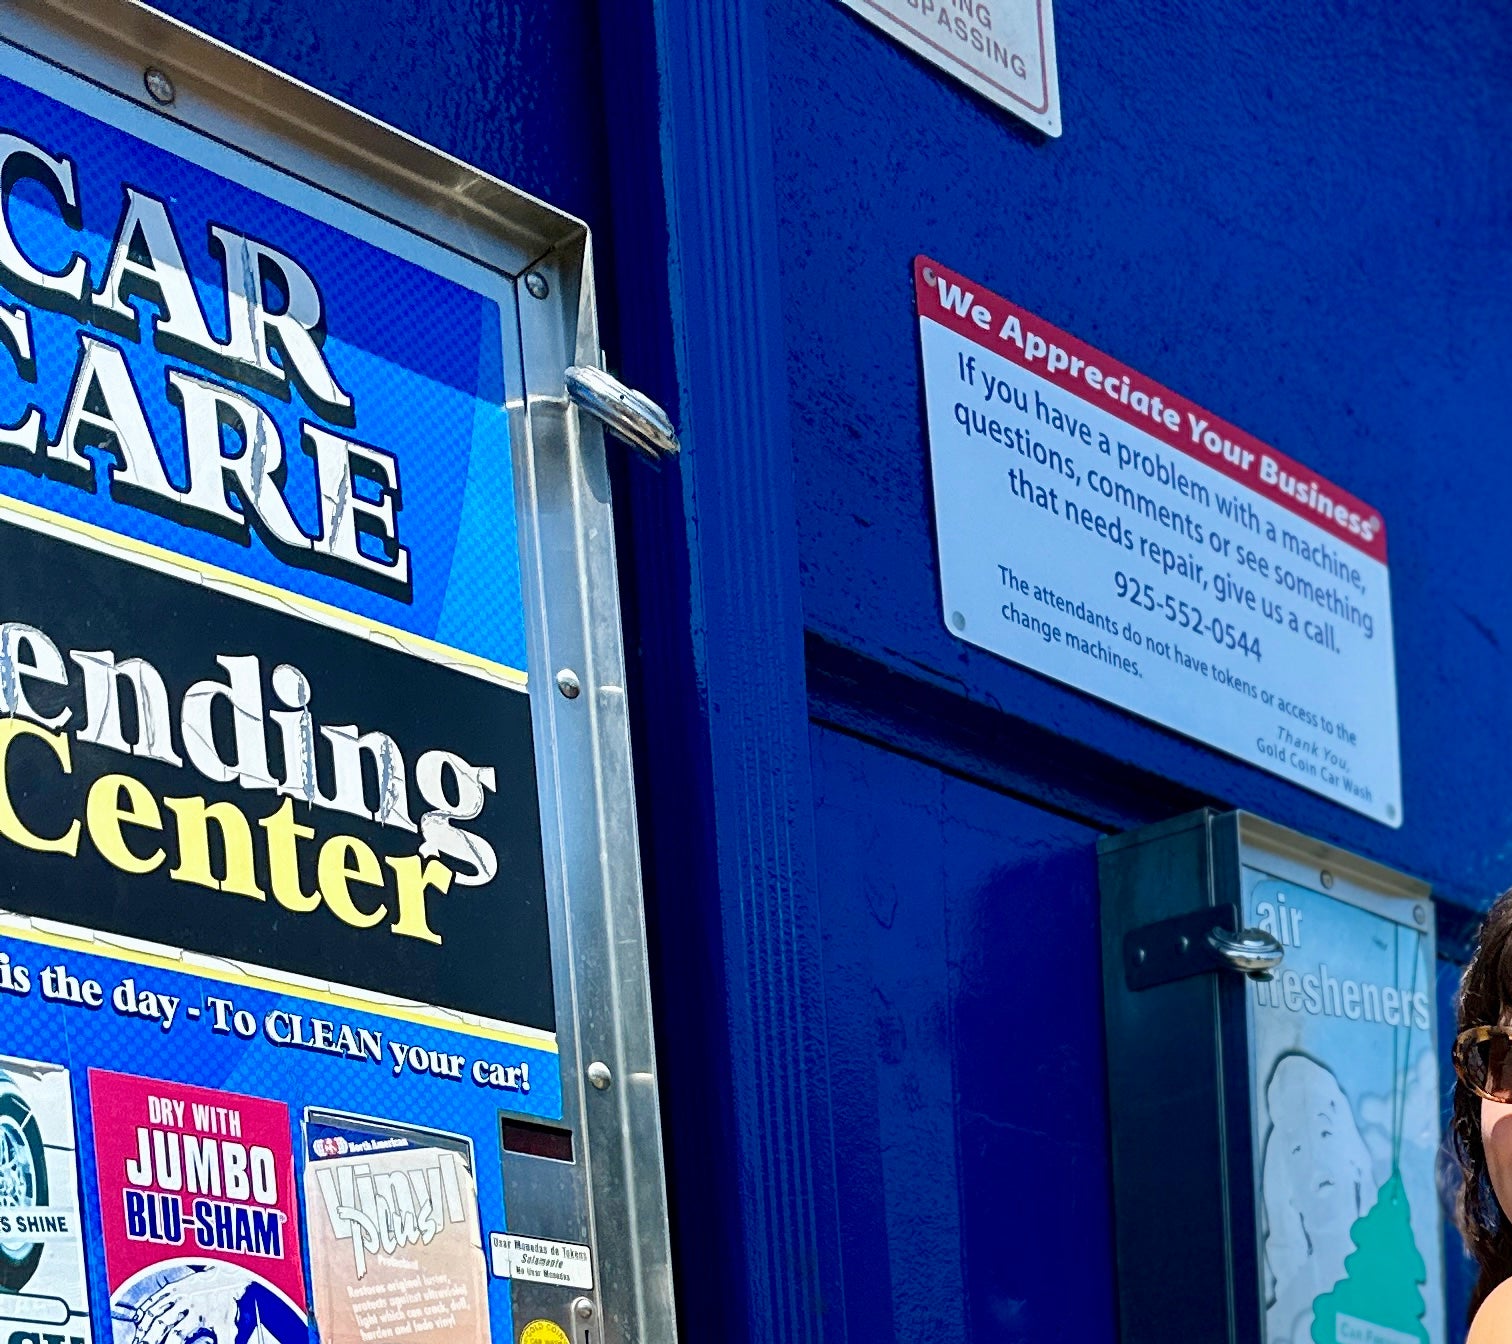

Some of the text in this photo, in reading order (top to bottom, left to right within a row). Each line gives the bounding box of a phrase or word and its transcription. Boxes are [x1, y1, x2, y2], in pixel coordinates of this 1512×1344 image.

[0, 131, 351, 408] CAR
[938, 277, 1374, 542] We Appreciate Your Business
[959, 352, 1366, 595] If you have a problem with a machine,
[954, 402, 1373, 639] questions, comments or see something
[1008, 467, 1341, 654] that needs repair, give us a call.
[998, 564, 1357, 747] The attendants do not have tokens or access to the
[1001, 602, 1142, 679] change machines.
[1114, 570, 1262, 663] 925-552-0544
[0, 622, 497, 886] ending
[1256, 737, 1373, 802] Gold Coin Car Wash
[1277, 726, 1350, 774] Thank You,
[0, 719, 455, 945] Center
[1256, 892, 1303, 948] air
[0, 953, 31, 993] is
[40, 966, 103, 1006] the
[113, 979, 180, 1029] day
[207, 997, 257, 1036] To
[265, 1010, 382, 1062] CLEAN
[389, 1041, 465, 1075] your
[472, 1060, 530, 1091] car!
[148, 1095, 242, 1137] DRY WITH
[125, 1126, 279, 1205] JUMBO
[316, 1154, 465, 1239] Vinyl
[0, 1215, 68, 1233] S SHINE
[125, 1190, 283, 1257] BLU-SHAM
[493, 1237, 511, 1249] Usar
[550, 1245, 560, 1256] de
[562, 1246, 587, 1261] Tokens
